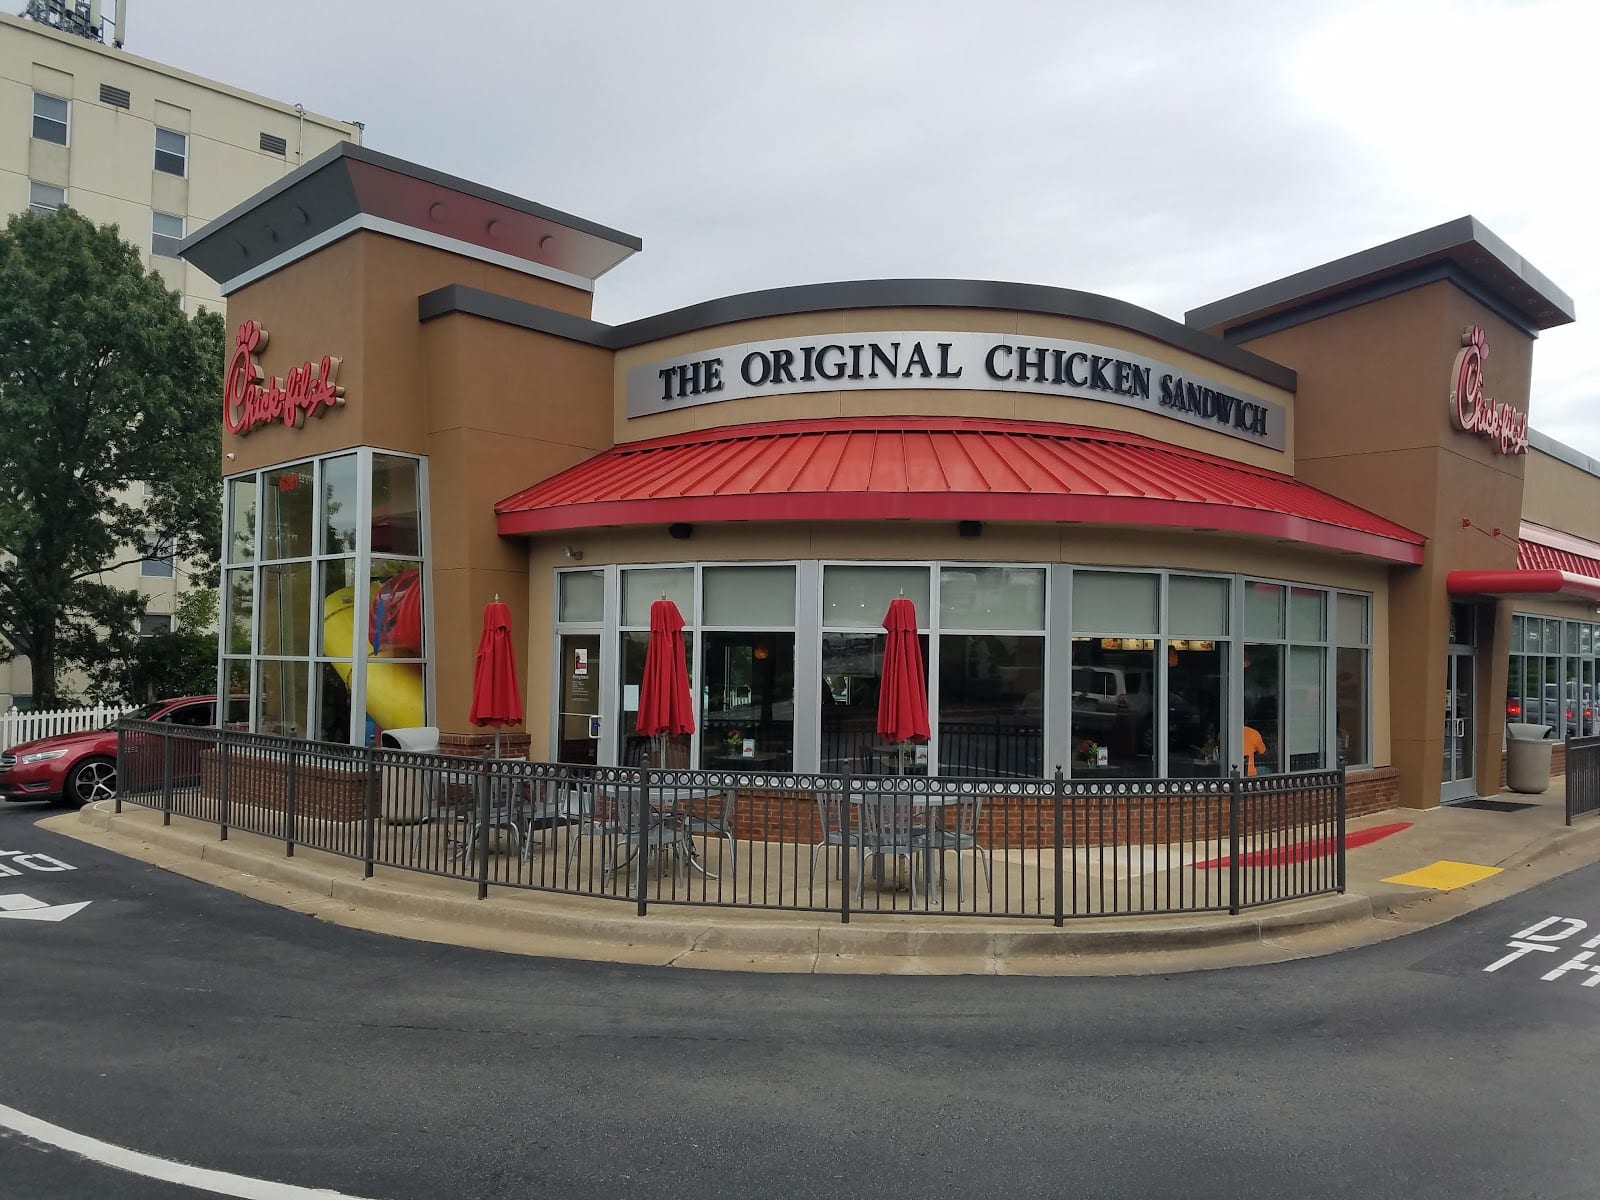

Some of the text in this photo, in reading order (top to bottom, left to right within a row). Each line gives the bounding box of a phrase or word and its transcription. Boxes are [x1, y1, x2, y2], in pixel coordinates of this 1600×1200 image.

[658, 341, 1269, 437] THE ORIGINAL CHICKEN SANDWICH
